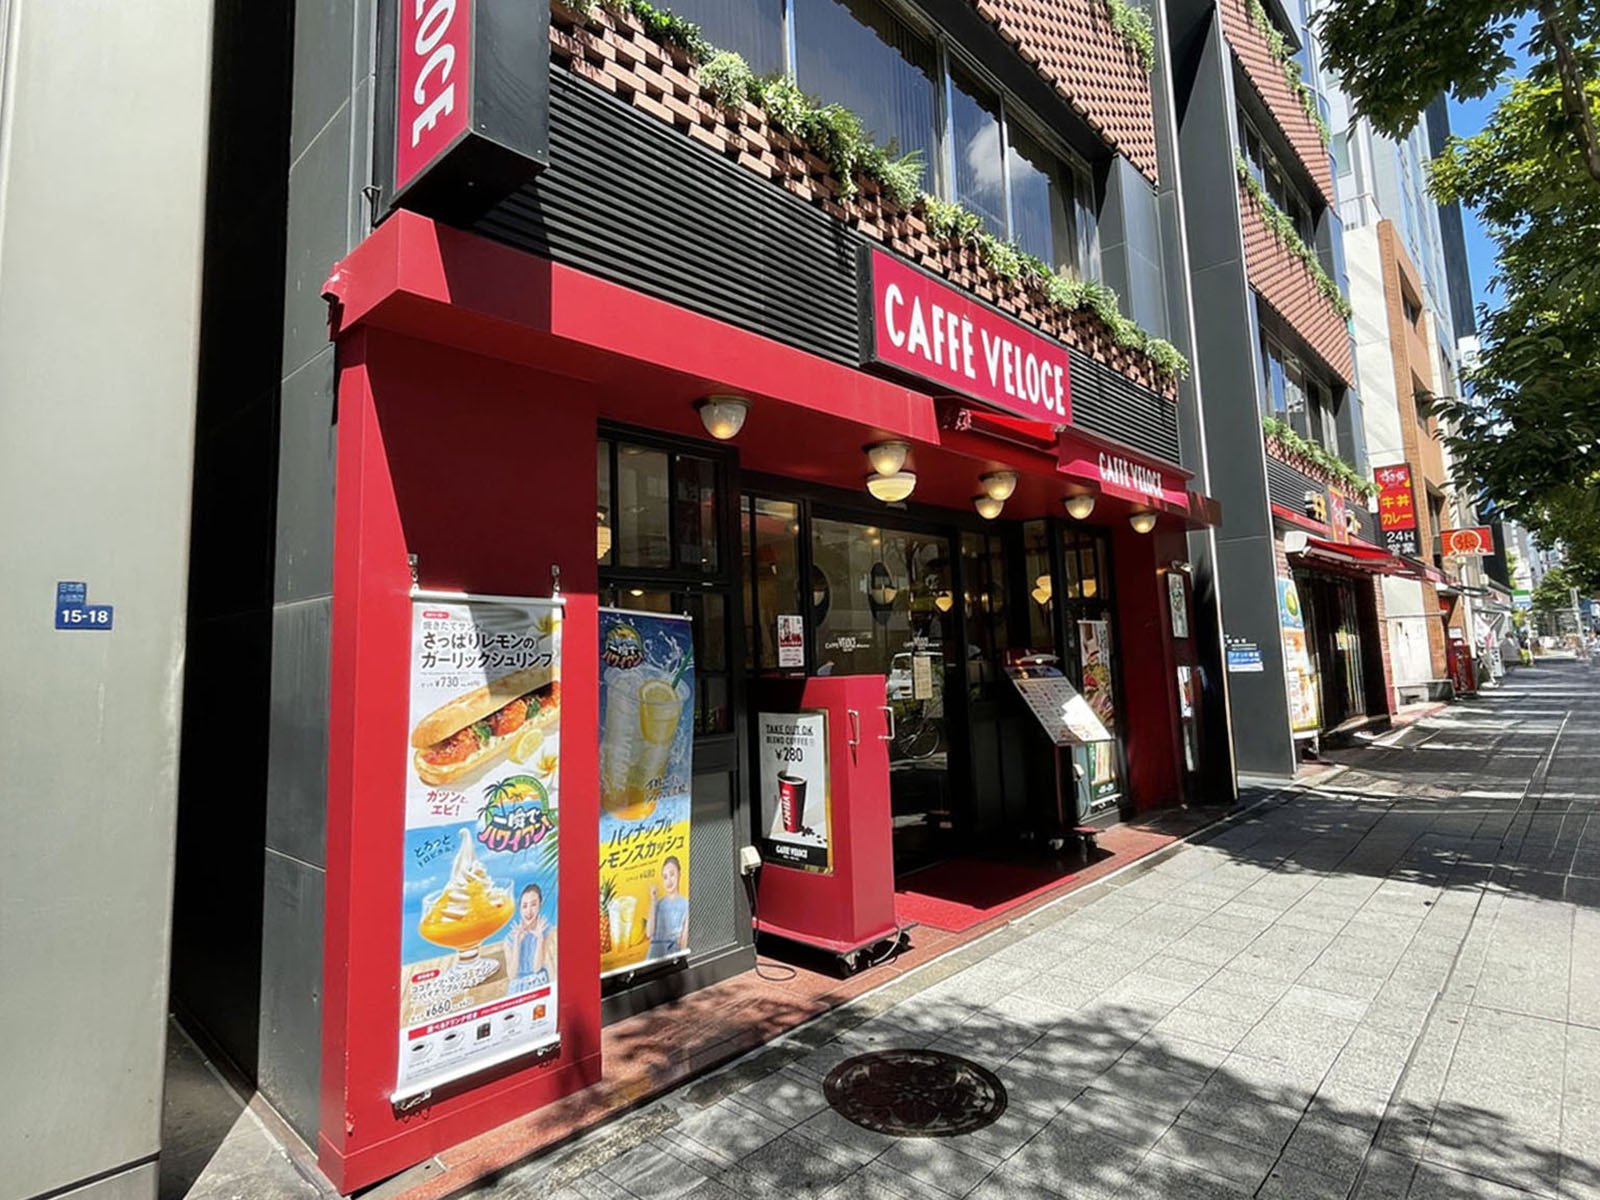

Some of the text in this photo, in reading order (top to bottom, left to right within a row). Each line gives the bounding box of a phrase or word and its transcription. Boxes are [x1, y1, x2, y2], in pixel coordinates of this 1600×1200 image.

[980, 328, 1066, 416] VELOCE
[1129, 463, 1164, 499] VELOCE
[1382, 512, 1413, 526] カレー
[1386, 531, 1415, 543] 24H
[62, 609, 109, 624] 15-18
[423, 631, 535, 650] さっぱりレモンの
[765, 724, 814, 736] TAKE OUT OK
[775, 748, 803, 762] ¥280
